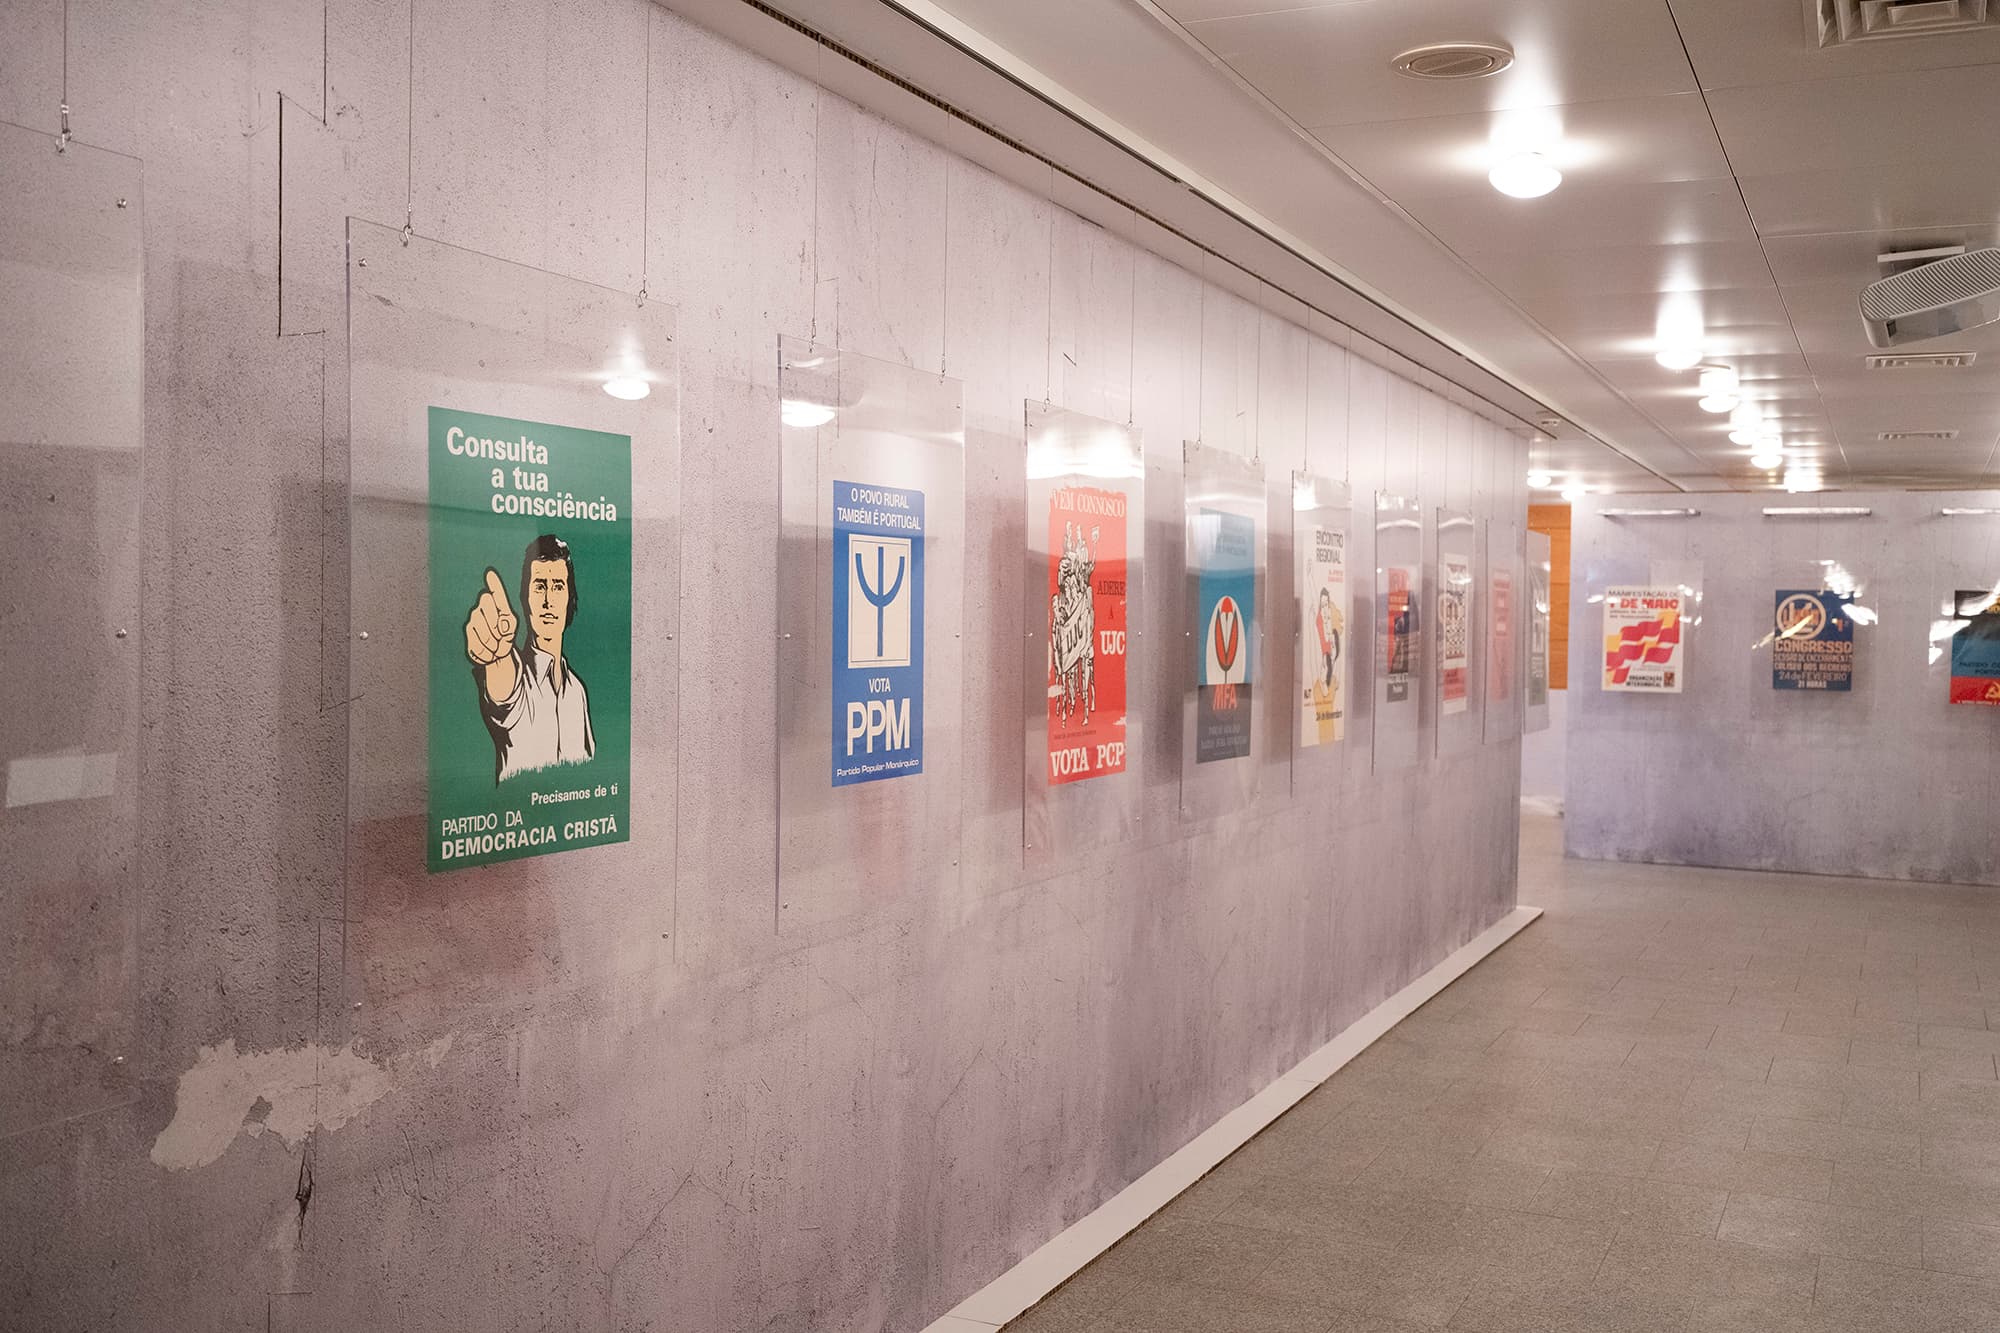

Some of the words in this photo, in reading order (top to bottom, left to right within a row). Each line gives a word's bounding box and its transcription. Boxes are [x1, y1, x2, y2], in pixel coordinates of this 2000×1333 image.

[447, 426, 549, 465] Consulta
[491, 468, 504, 488] a
[512, 466, 549, 492] tua
[491, 492, 617, 521] consciência
[851, 488, 859, 502] O
[859, 489, 883, 506] POVO
[884, 493, 909, 509] RURAL
[1053, 488, 1074, 512] VEM
[1077, 494, 1125, 518] CONNOSCO
[837, 507, 872, 525] TAMBÉM
[873, 509, 879, 526] É
[880, 513, 921, 530] PORTUGAL
[1316, 530, 1344, 549] ENCONTRO
[1097, 580, 1126, 596] ADERE
[1620, 598, 1638, 609] DE
[1641, 597, 1679, 609] MAIO
[1066, 615, 1083, 654] UJC
[1100, 630, 1126, 655] UJC
[1774, 641, 1852, 653] CONGRESSO
[868, 677, 891, 693] VOTA
[1213, 684, 1237, 711] MFA
[847, 698, 910, 756] PPM
[837, 766, 860, 777] Partido
[861, 763, 885, 774] Popular
[885, 758, 919, 770] Monárquico
[1050, 747, 1090, 777] VOTA
[1096, 742, 1125, 769] PCP
[531, 790, 590, 806] Precisamos
[594, 785, 607, 798] de
[611, 783, 618, 796] ti
[442, 813, 497, 836] PARTIDO
[505, 810, 523, 827] DA
[441, 826, 557, 860] DEMOCRACIA
[563, 814, 617, 841] CRISTÃ
